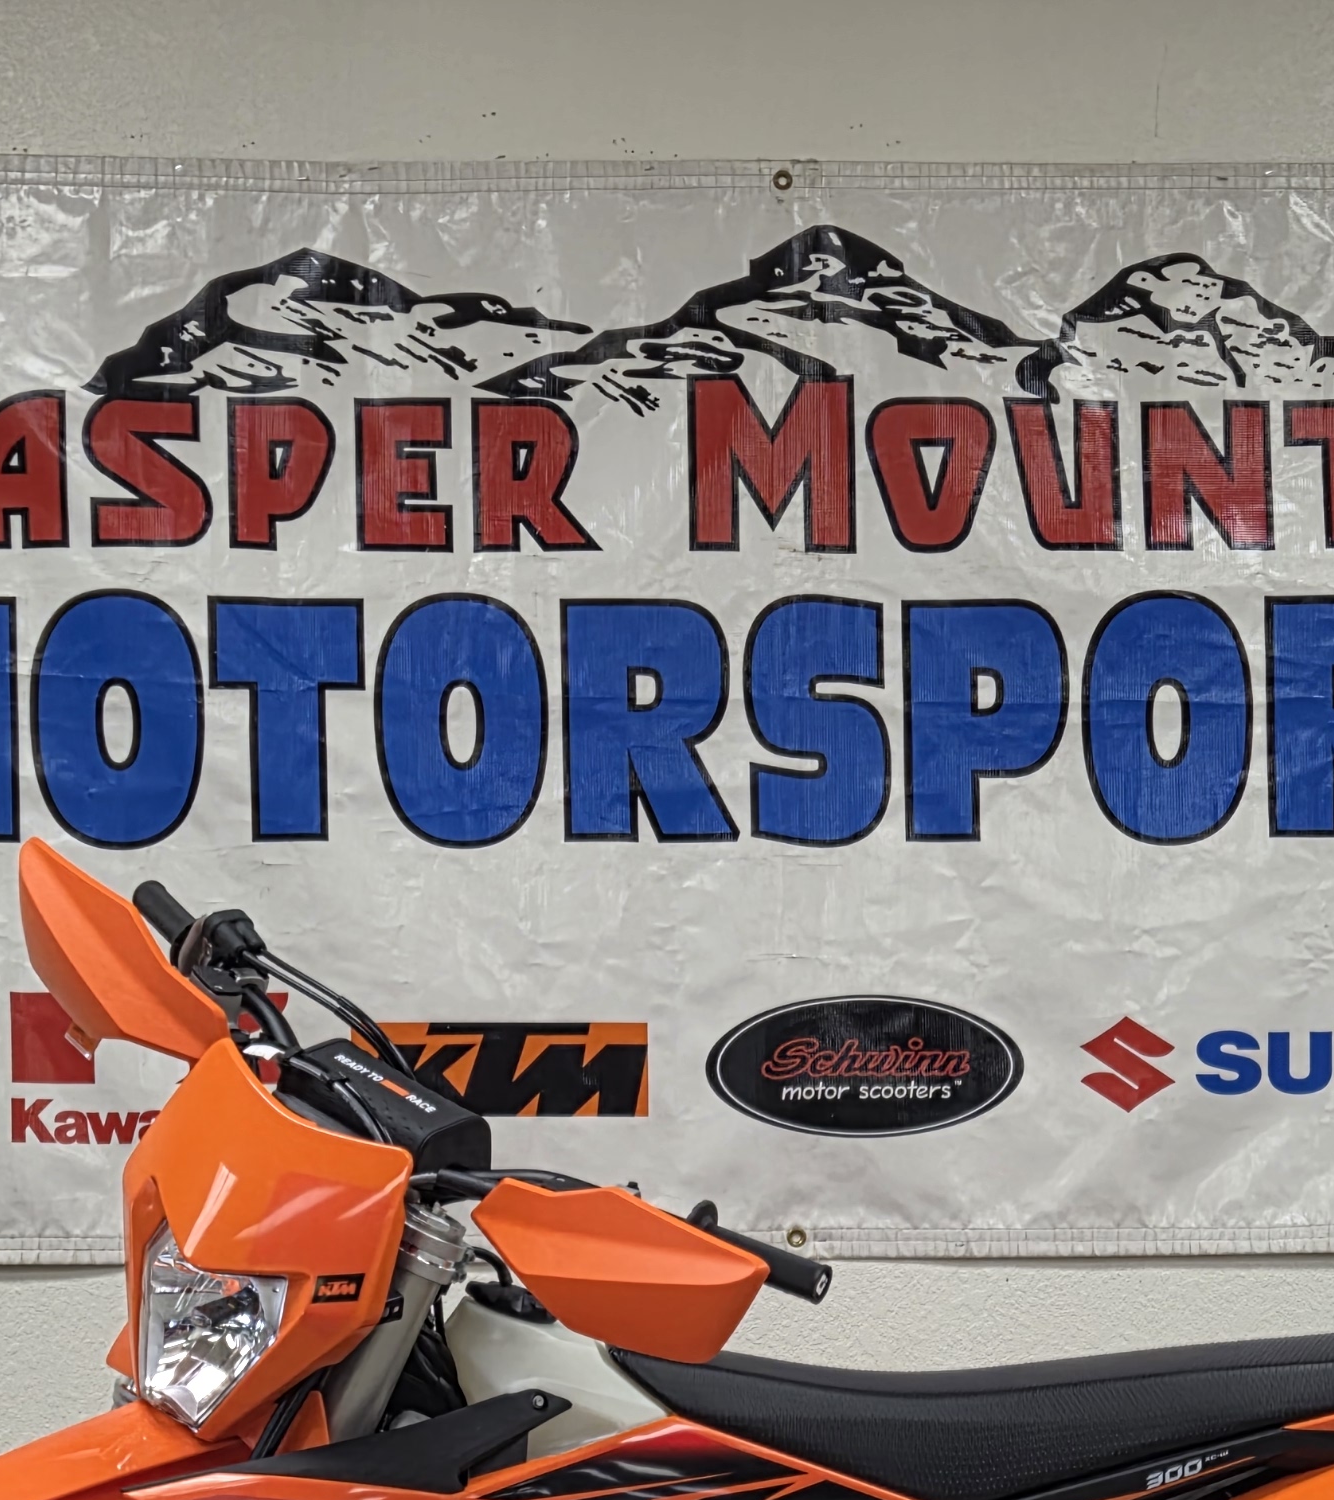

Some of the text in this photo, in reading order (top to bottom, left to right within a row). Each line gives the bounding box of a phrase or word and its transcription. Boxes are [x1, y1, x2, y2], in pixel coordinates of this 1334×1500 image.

[761, 1037, 970, 1080] Schwinn
[334, 1053, 437, 1114] READY TO RACE
[781, 1082, 850, 1100] motor
[317, 1281, 357, 1297] KTM
[1146, 1458, 1203, 1491] 300
